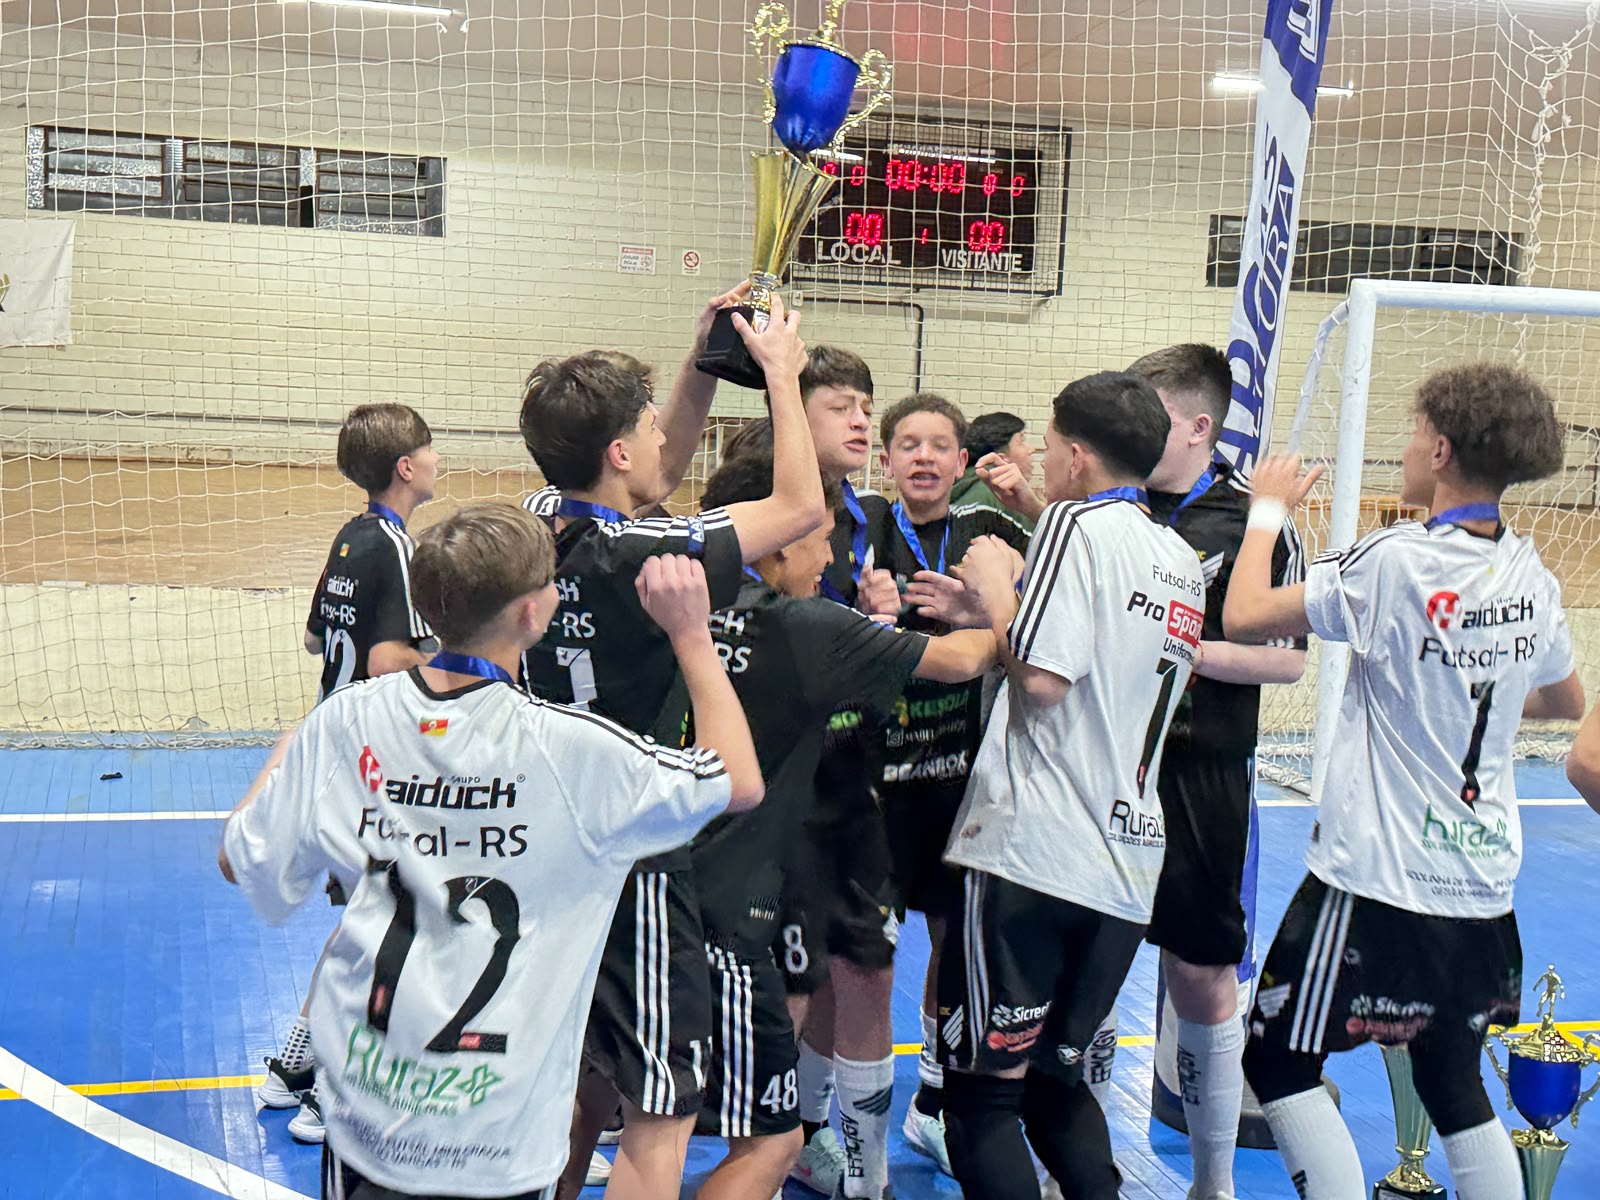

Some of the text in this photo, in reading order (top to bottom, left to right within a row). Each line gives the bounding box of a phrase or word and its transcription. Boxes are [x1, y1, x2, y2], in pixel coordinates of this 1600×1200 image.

[885, 159, 966, 194] 00:00
[845, 212, 884, 245] 00
[967, 220, 1005, 252] 00
[816, 240, 901, 265] LOCAL
[941, 248, 1023, 272] VISITANTE
[1126, 590, 1166, 622] Pro
[366, 853, 522, 1055] 12
[783, 924, 809, 974] 8
[760, 1068, 799, 1114] 48
